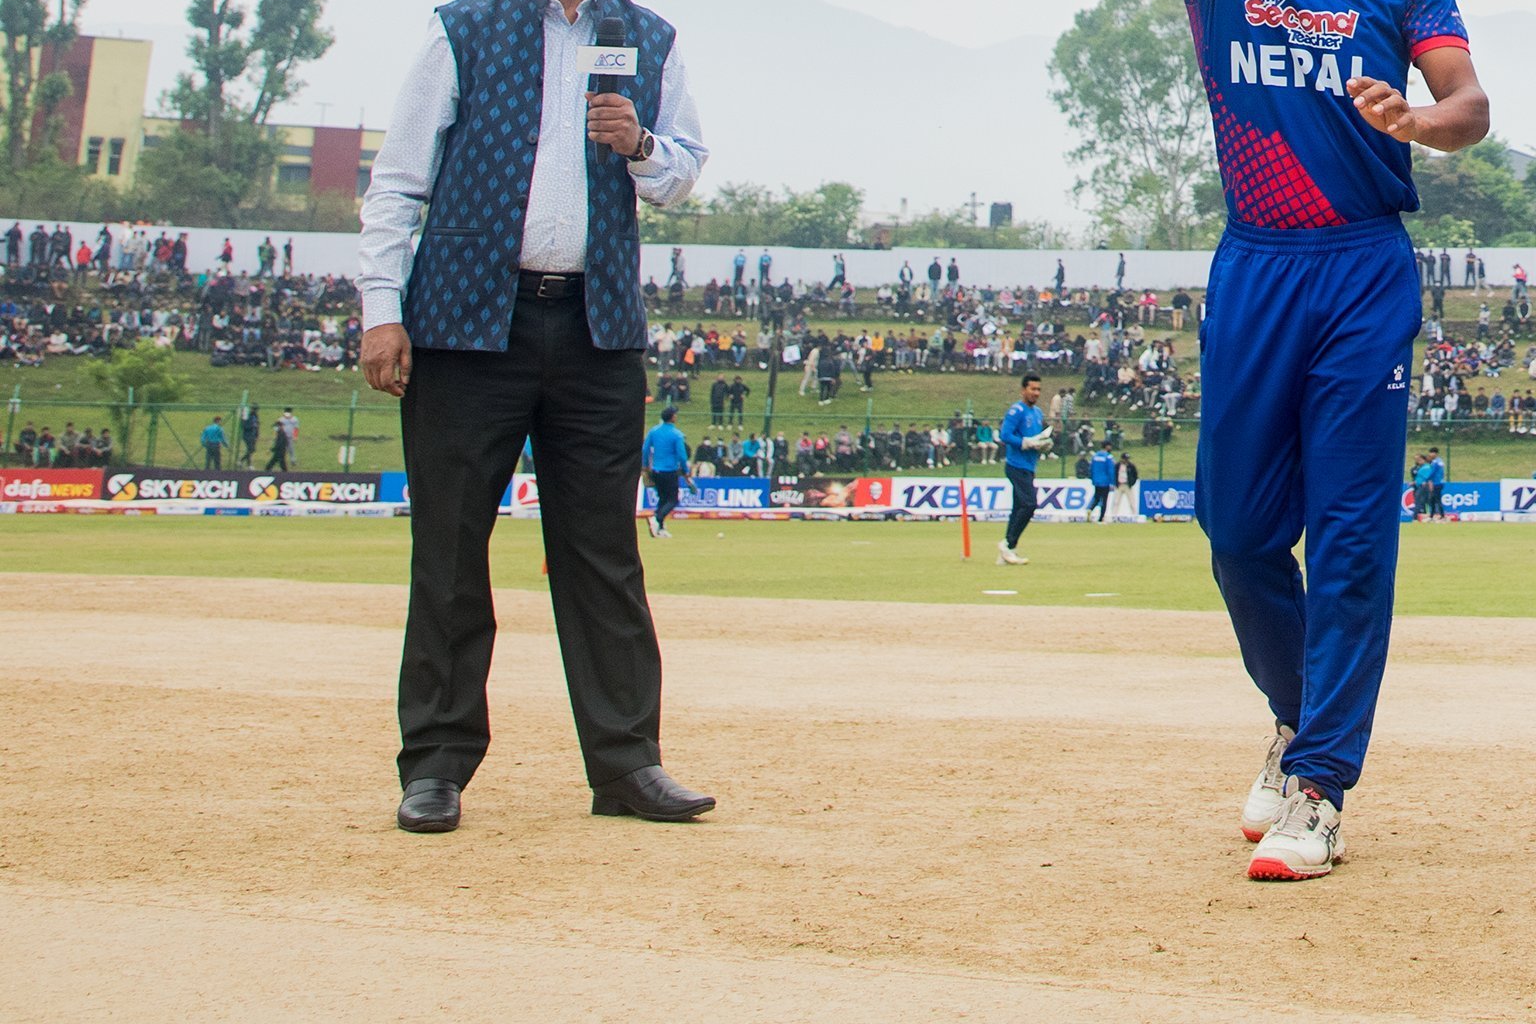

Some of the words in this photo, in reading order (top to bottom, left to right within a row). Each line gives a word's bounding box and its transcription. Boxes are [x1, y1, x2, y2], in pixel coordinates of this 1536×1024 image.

[1289, 29, 1341, 48] Teacher
[594, 53, 626, 67] ACC
[139, 479, 238, 499] SKYEXCH
[279, 481, 376, 502] SKYEXCH
[903, 485, 1006, 510] 1XBAT
[1440, 490, 1480, 509] epsi
